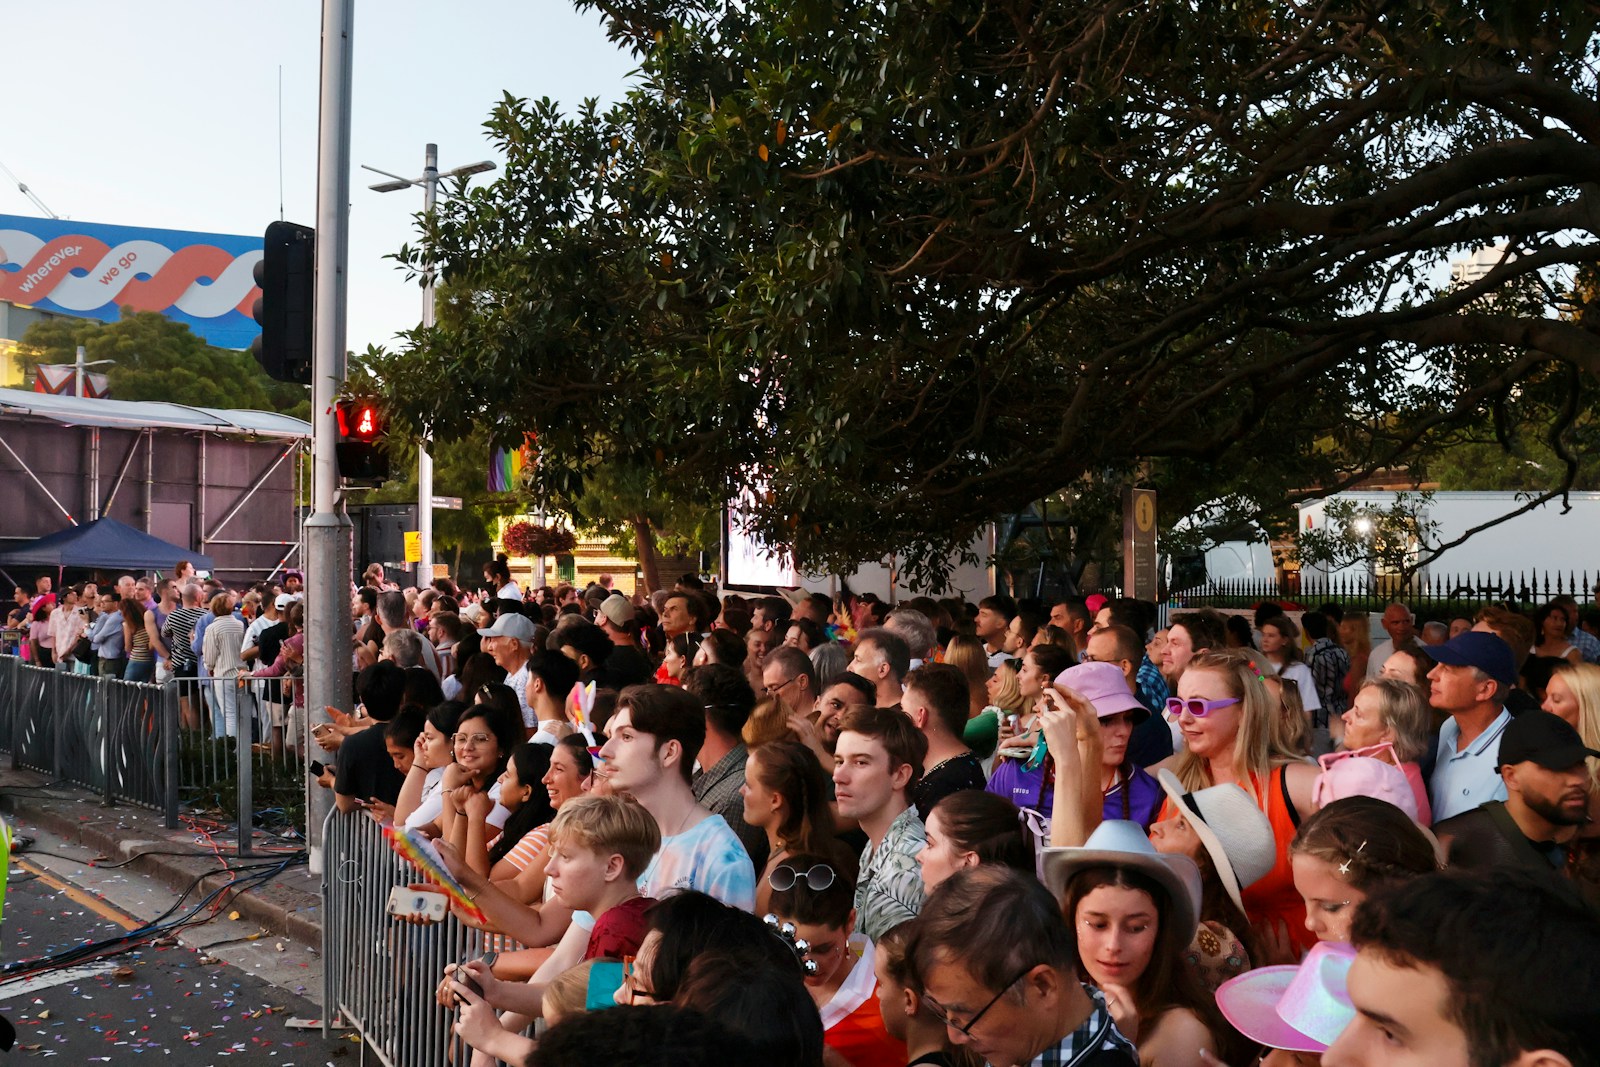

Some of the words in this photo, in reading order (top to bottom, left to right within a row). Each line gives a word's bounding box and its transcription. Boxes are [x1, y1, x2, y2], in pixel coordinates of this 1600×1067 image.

[19, 245, 82, 293] wherever
[99, 267, 120, 286] we
[118, 252, 137, 269] go
